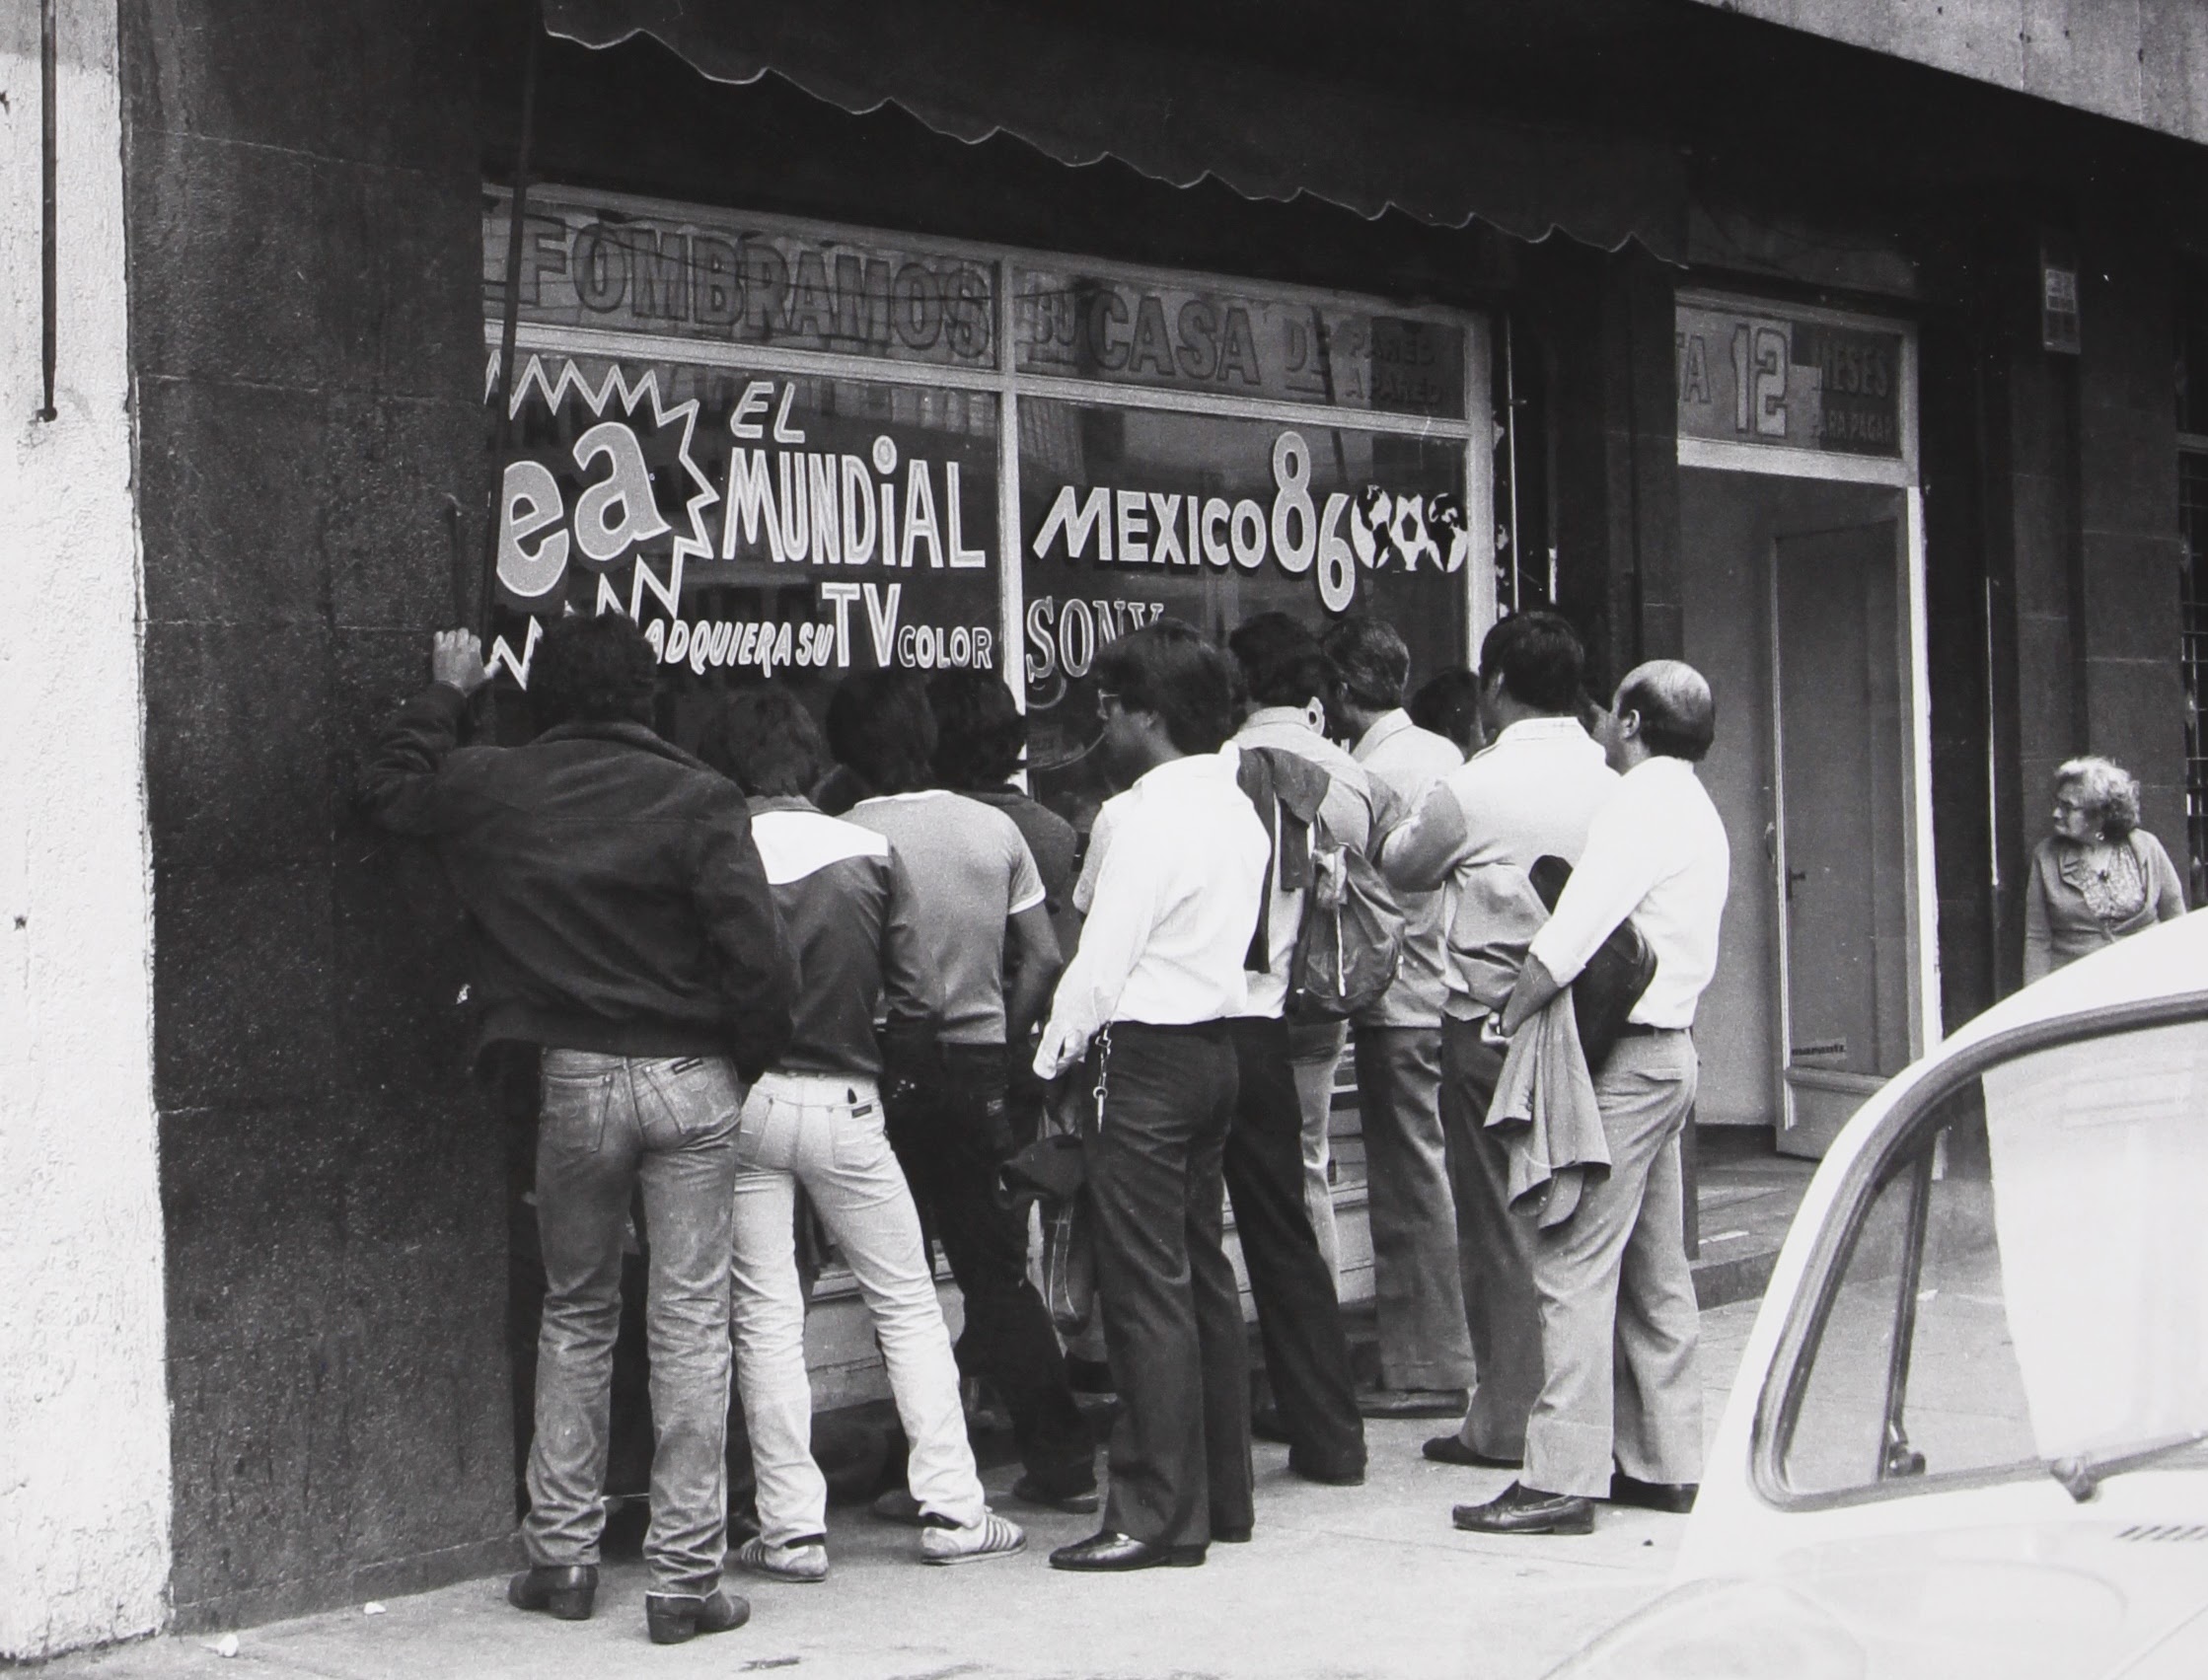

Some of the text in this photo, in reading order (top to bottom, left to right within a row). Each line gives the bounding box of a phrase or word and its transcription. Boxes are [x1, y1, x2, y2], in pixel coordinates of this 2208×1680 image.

[1089, 292, 1262, 386] CASA
[1730, 323, 1789, 438] 12
[729, 381, 806, 443] EL
[1032, 485, 1268, 569] MEXICO
[1272, 431, 1357, 613] 86
[644, 582, 993, 679] ADQUIERA SU TV COLOR
